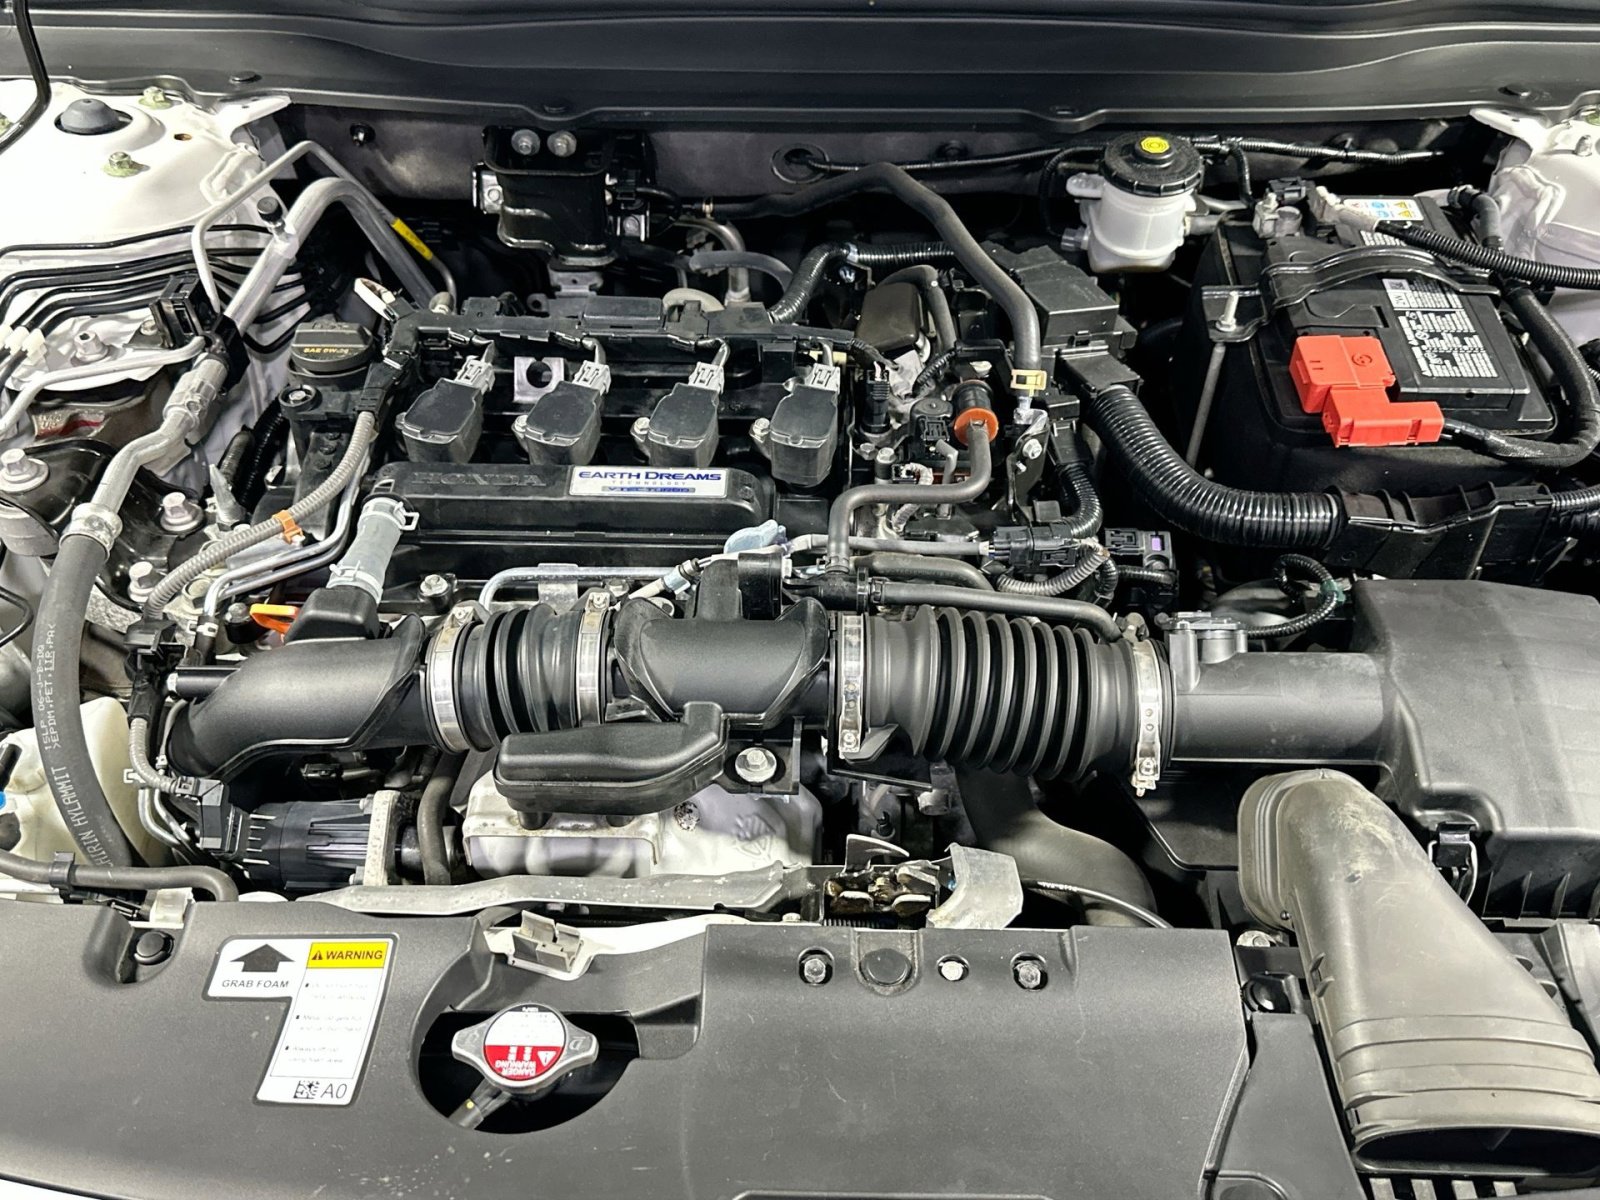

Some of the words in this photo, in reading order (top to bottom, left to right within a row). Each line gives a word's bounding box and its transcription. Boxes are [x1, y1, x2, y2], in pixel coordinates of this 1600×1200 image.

[411, 471, 547, 487] HONDA
[578, 470, 642, 480] EARTH
[644, 471, 722, 481] DREAMS
[50, 766, 89, 827] HYLAMMIT
[325, 950, 383, 960] WARNING
[221, 979, 254, 988] GRAB
[255, 980, 290, 988] FOAM
[501, 1068, 536, 1076] DANGER
